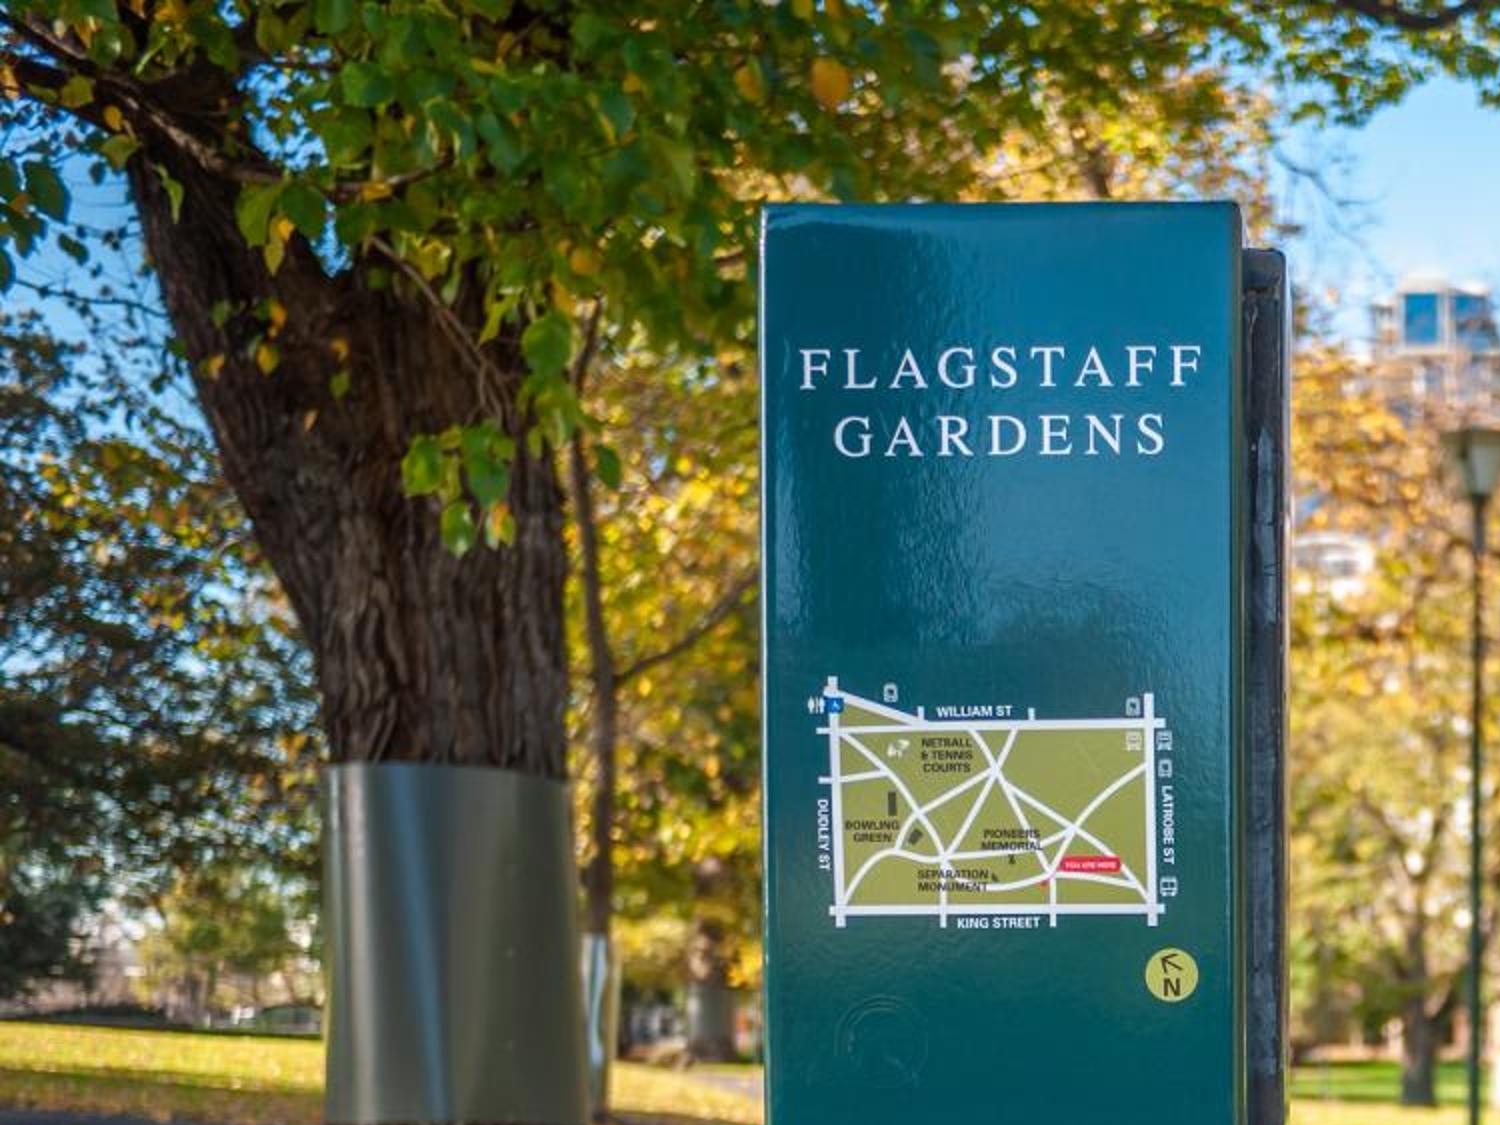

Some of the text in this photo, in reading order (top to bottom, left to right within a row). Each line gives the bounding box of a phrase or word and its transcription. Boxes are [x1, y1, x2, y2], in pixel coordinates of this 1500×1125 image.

[800, 346, 1201, 389] FLAGSTAFF
[833, 413, 1165, 457] GARDENS
[936, 705, 1013, 718] WILLIAM ST
[922, 738, 972, 748] NETBALL
[932, 750, 973, 760] TENNIS
[923, 763, 971, 773] COURTS
[845, 820, 900, 831] BOWLING
[817, 799, 830, 871] DUDLEY ST
[853, 833, 892, 843] GREEN
[983, 829, 1041, 839] PIONEERS
[981, 842, 1042, 851] MEMORIAL
[1164, 847, 1175, 865] ST
[917, 870, 989, 879] SEPARATION
[917, 882, 988, 892] MONUMENT
[957, 917, 1041, 929] KING STREET
[1163, 978, 1181, 997] N
